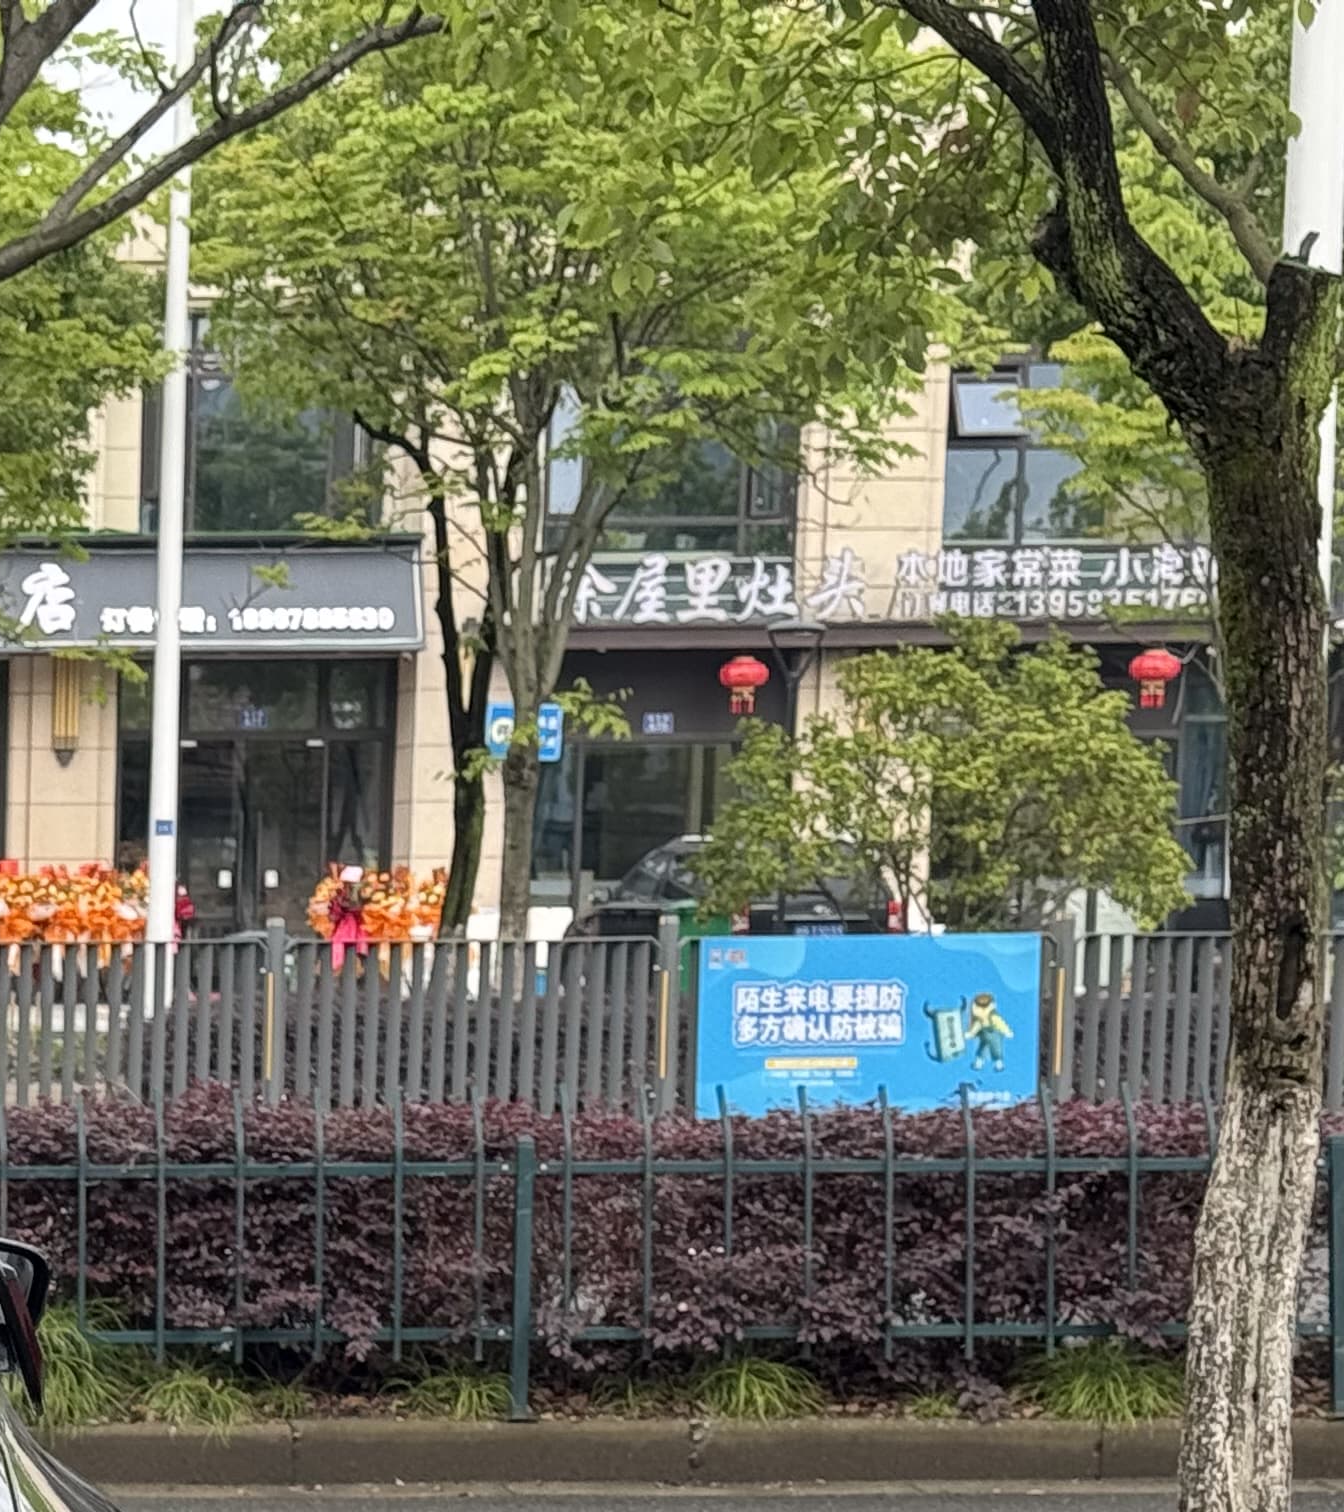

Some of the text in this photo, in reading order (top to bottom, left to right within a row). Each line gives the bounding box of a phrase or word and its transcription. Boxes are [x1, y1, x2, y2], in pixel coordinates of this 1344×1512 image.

[895, 546, 1082, 588] 本地家常菜
[736, 984, 905, 1014] 陌生来电要提防
[737, 1013, 903, 1042] 多方确认防被骗
